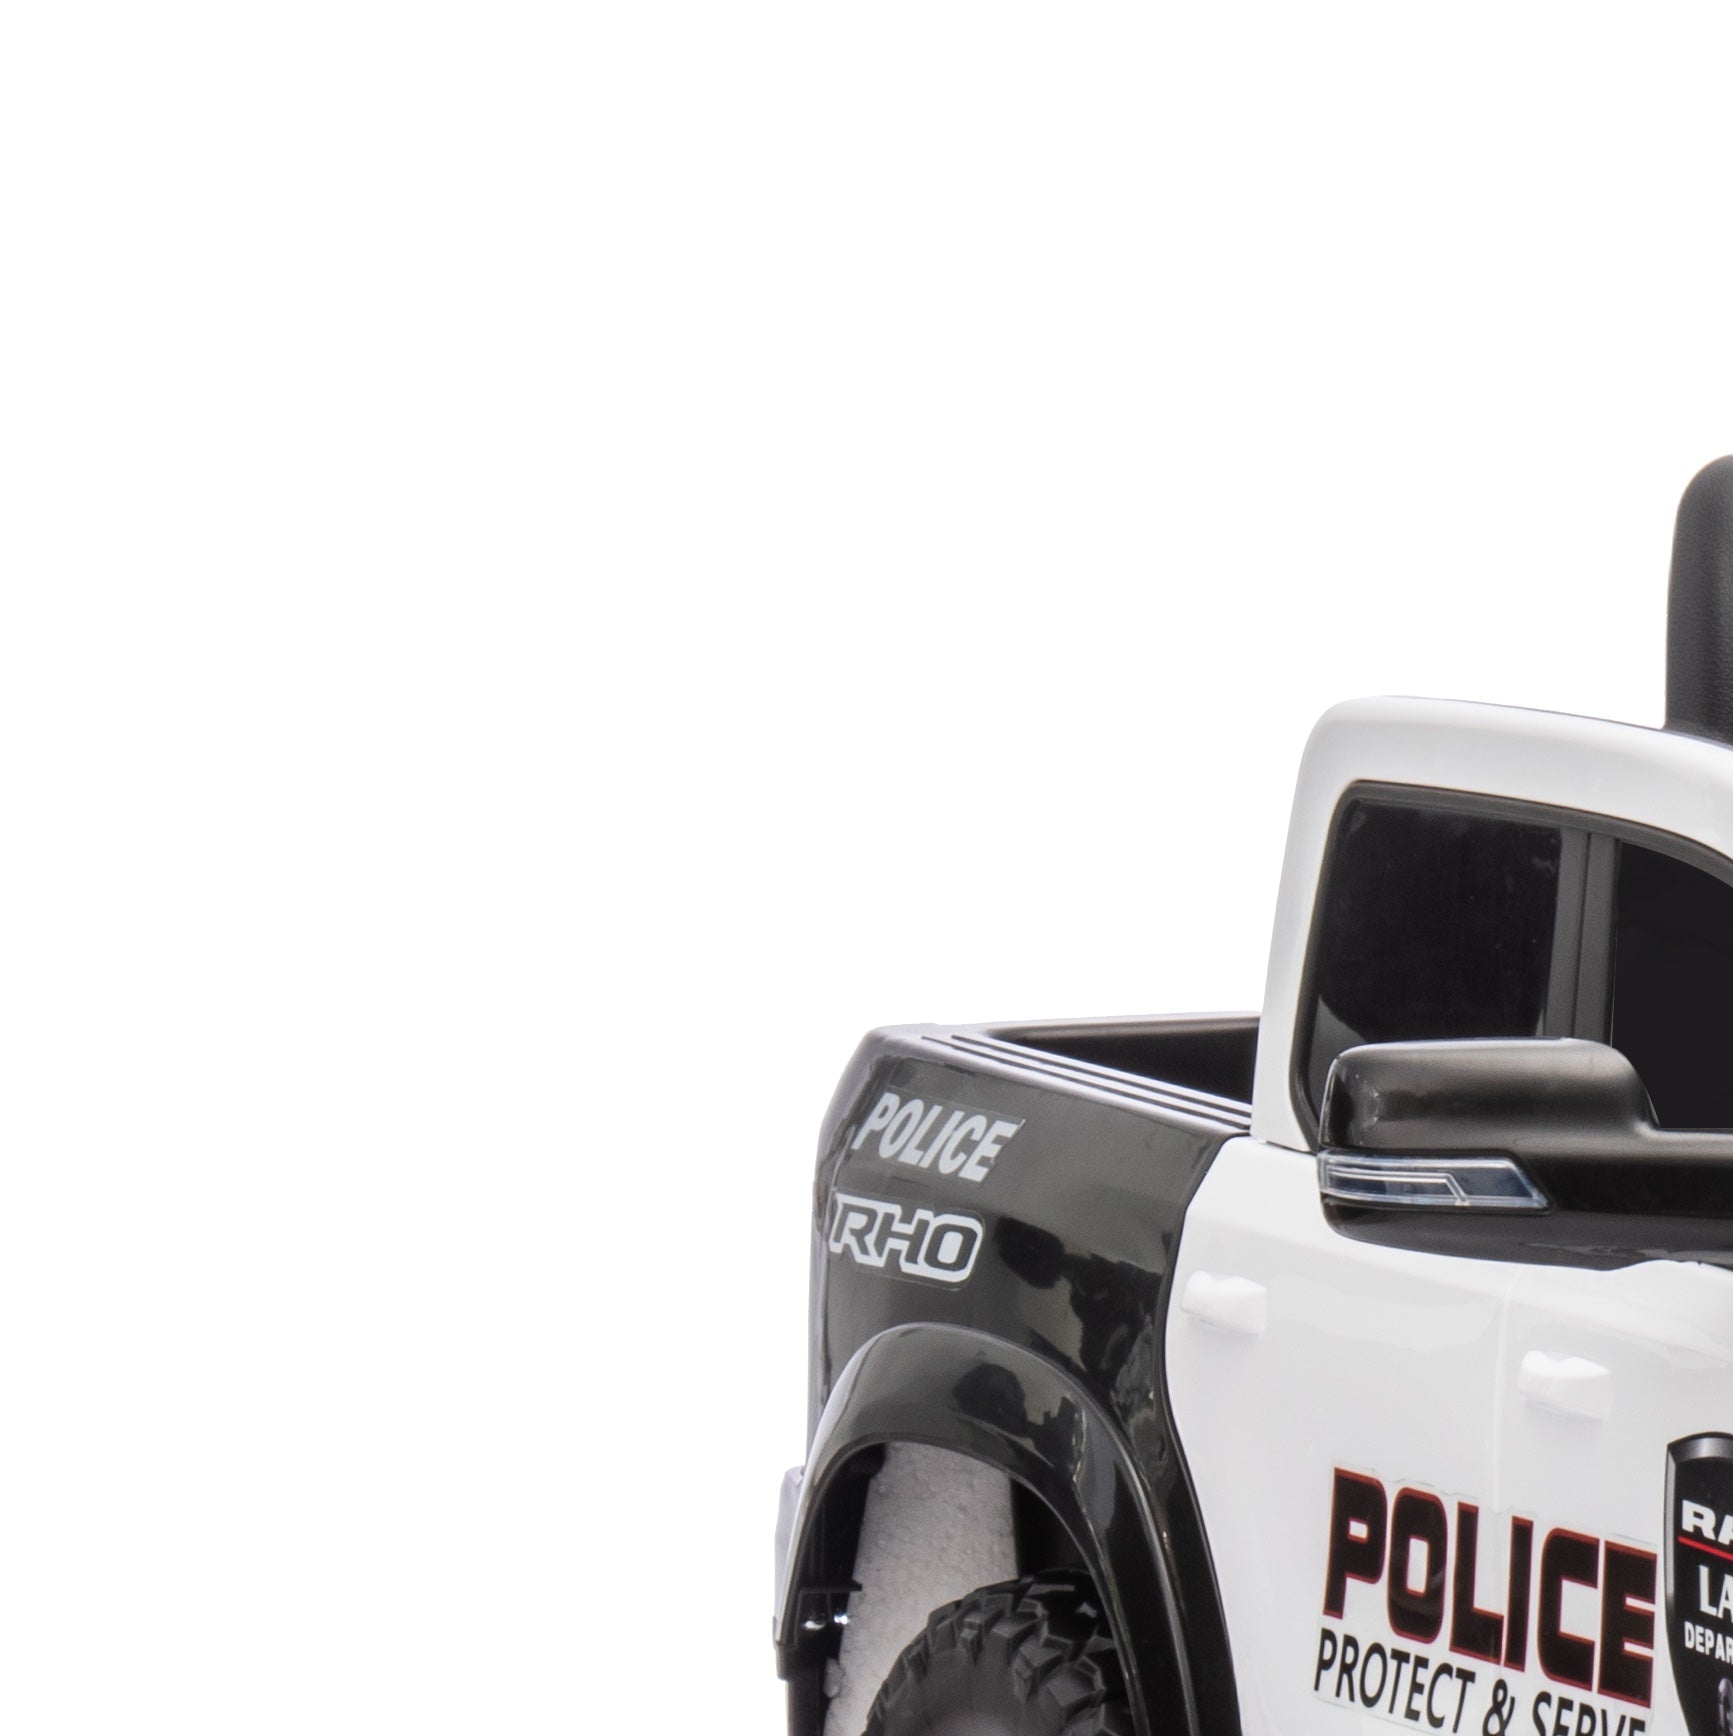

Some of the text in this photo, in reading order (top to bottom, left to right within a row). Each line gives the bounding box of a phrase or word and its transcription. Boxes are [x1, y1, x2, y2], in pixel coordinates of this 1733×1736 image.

[851, 1092, 1020, 1183] POLICE
[829, 1194, 984, 1283] RHO
[1322, 1466, 1658, 1709] POLICE
[1314, 1627, 1477, 1734] PROTECT
